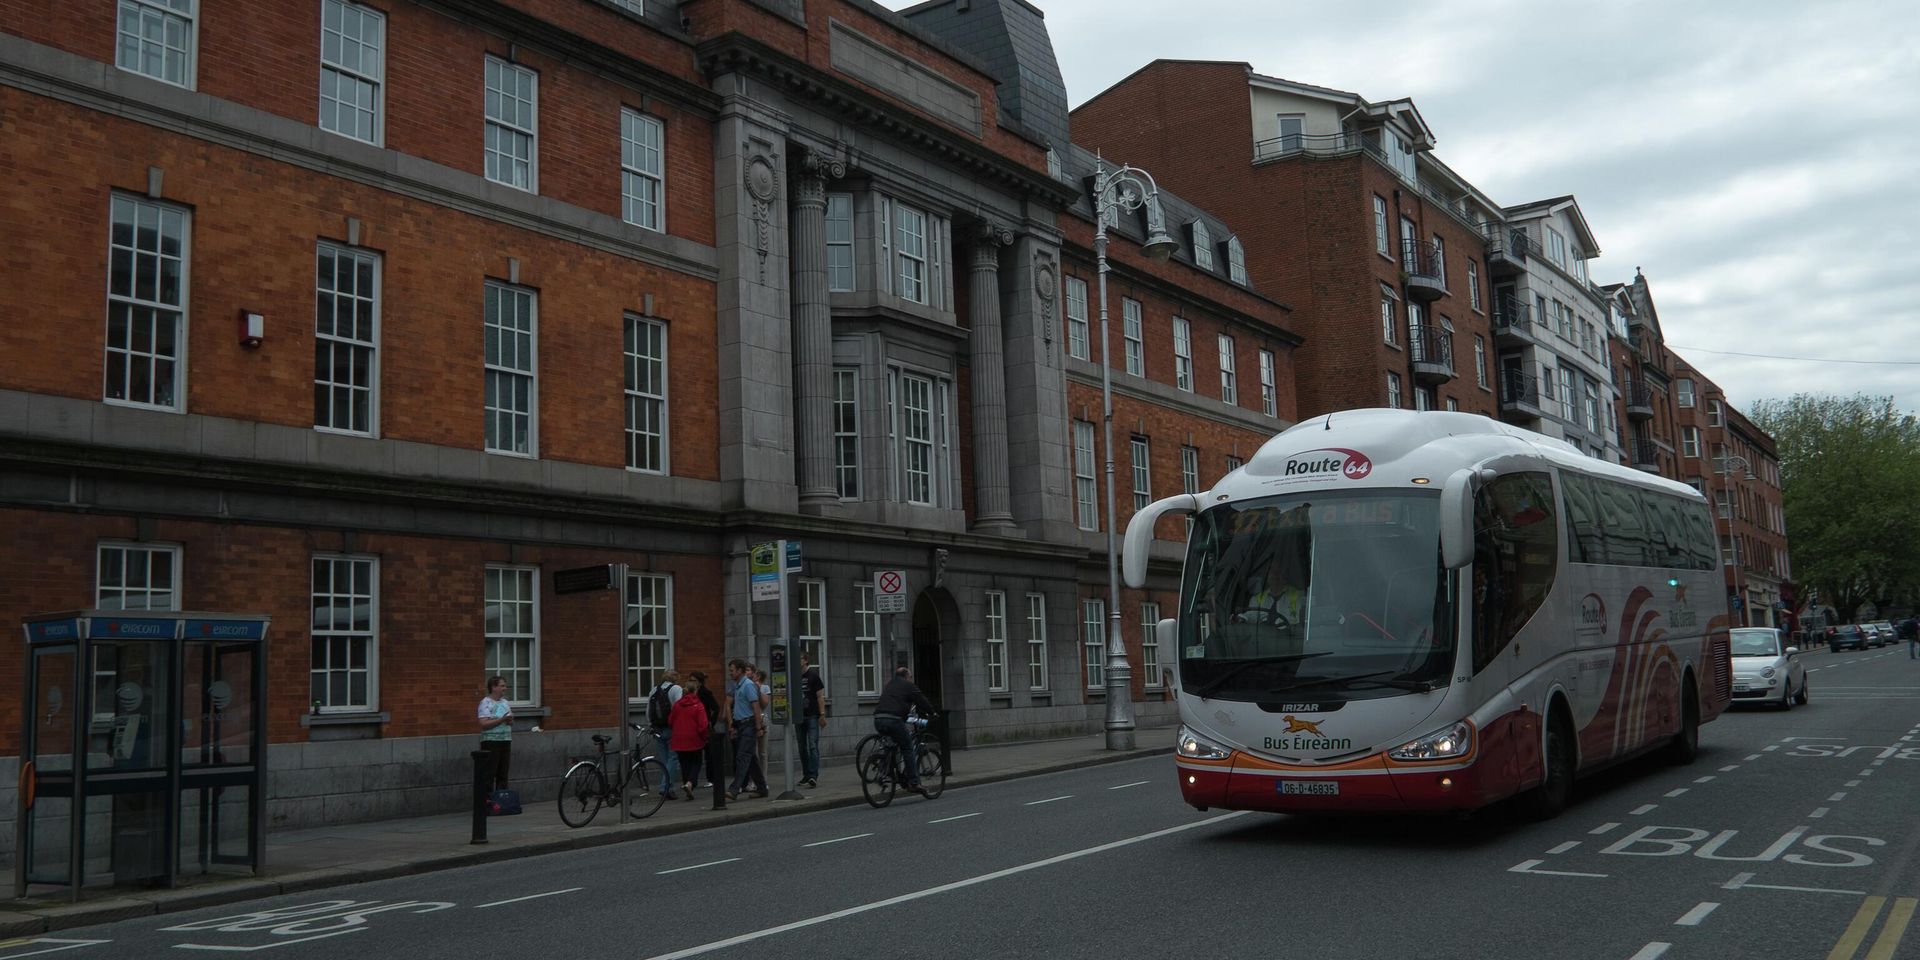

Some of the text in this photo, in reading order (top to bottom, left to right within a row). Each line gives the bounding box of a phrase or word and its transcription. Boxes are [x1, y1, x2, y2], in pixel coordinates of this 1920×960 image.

[1285, 458, 1369, 475] Route 64
[121, 623, 161, 635] eircom
[212, 624, 249, 636] eircom
[1282, 703, 1319, 712] IRIZAR
[1264, 737, 1289, 750] Bus
[1284, 783, 1335, 794] 06-D-46835
[1598, 825, 1887, 867] BUS
